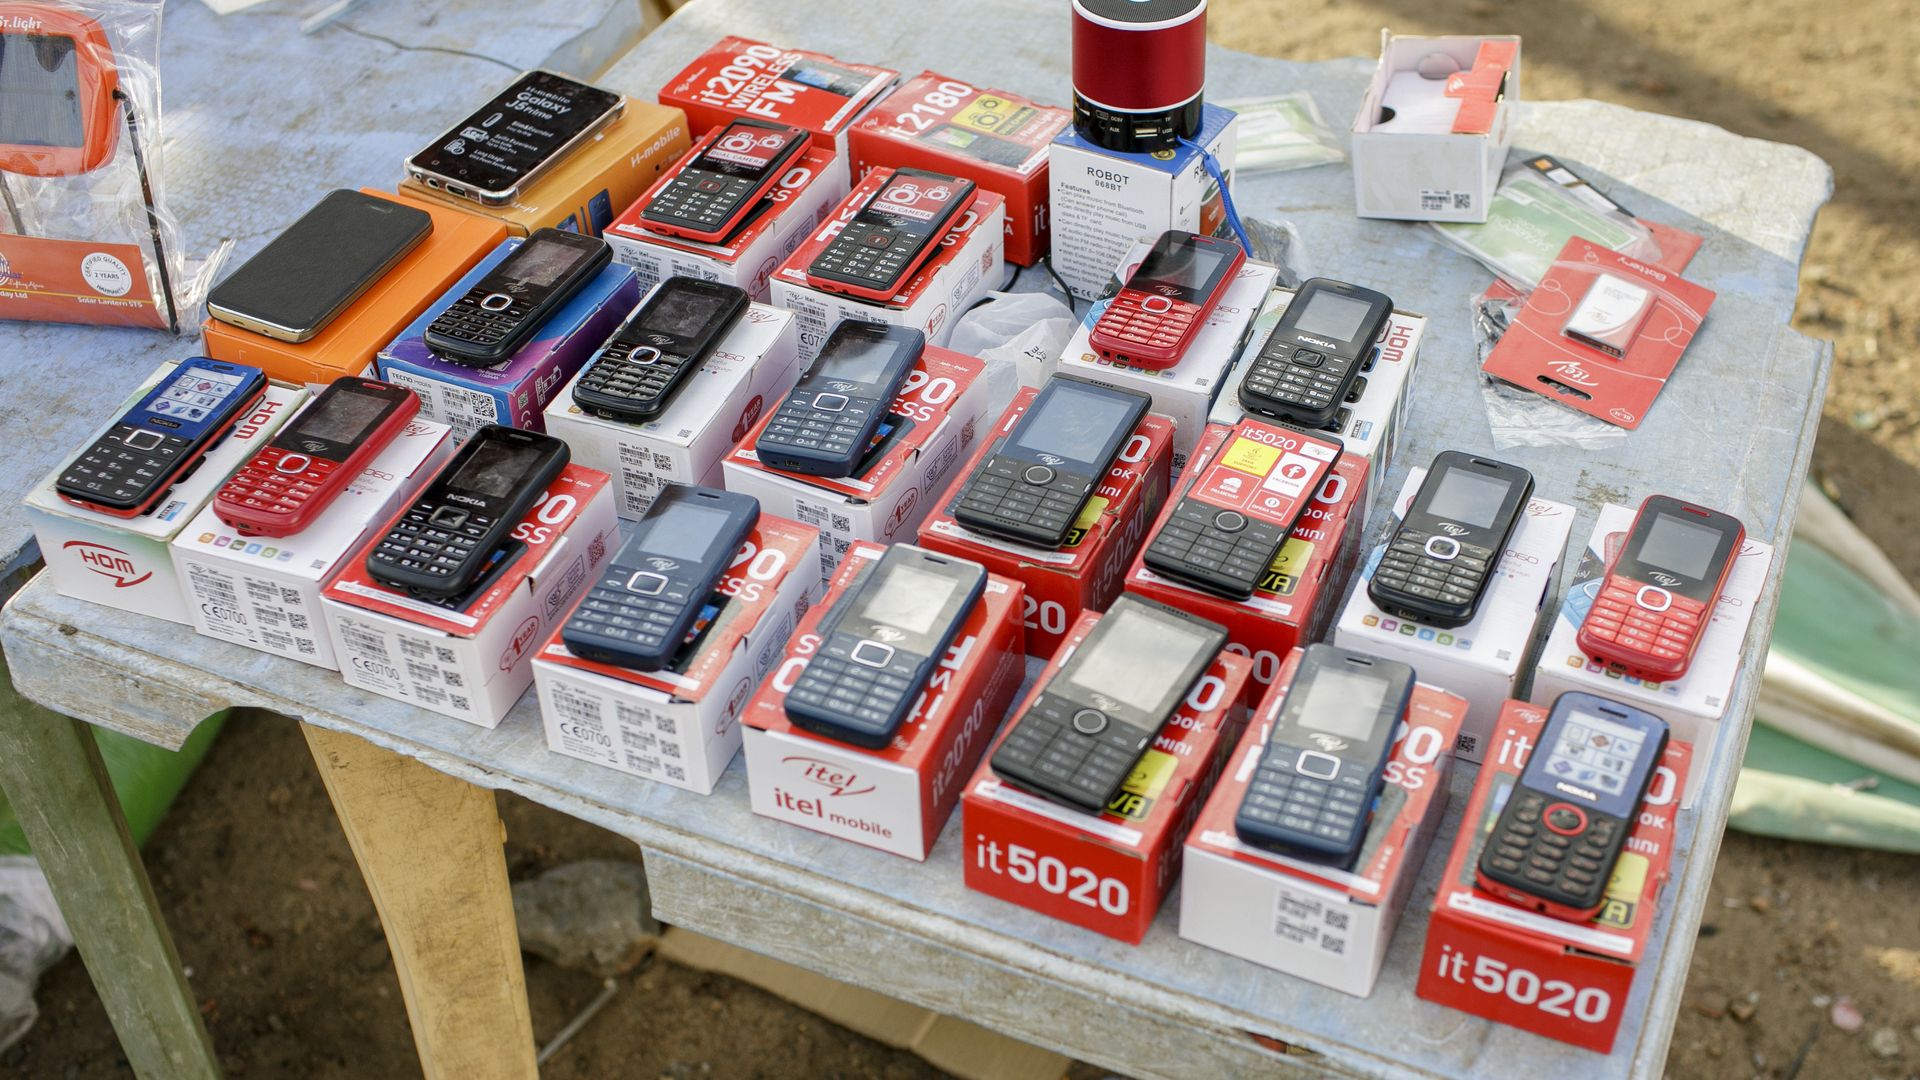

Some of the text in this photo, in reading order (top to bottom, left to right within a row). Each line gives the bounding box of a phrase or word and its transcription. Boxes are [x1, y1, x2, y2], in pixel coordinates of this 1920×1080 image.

[691, 45, 782, 106] it2090
[726, 52, 803, 109] WIRELESS
[505, 100, 553, 120] J5 Prime
[517, 91, 572, 114] Galaxy
[746, 80, 808, 119] FM
[879, 81, 974, 141] it2180
[630, 126, 681, 168] H-mobile
[733, 154, 766, 167] CAMERA
[1087, 167, 1130, 186] ROBOT
[1061, 182, 1091, 195] Features
[875, 203, 933, 220] DUAL CAMERA
[1617, 257, 1667, 283] Battery
[648, 334, 675, 345] itel
[1297, 335, 1337, 350] NOKIA
[1241, 426, 1298, 451] it5020
[446, 493, 487, 508] NOKIA
[1292, 525, 1327, 541] MINI
[1437, 522, 1471, 537] itel
[1647, 571, 1683, 587] itel
[932, 698, 983, 806] it2090
[1154, 735, 1194, 757] MINI
[774, 787, 893, 841] itel mobile
[976, 834, 1130, 916] it5020
[1437, 944, 1613, 1025] it5020
